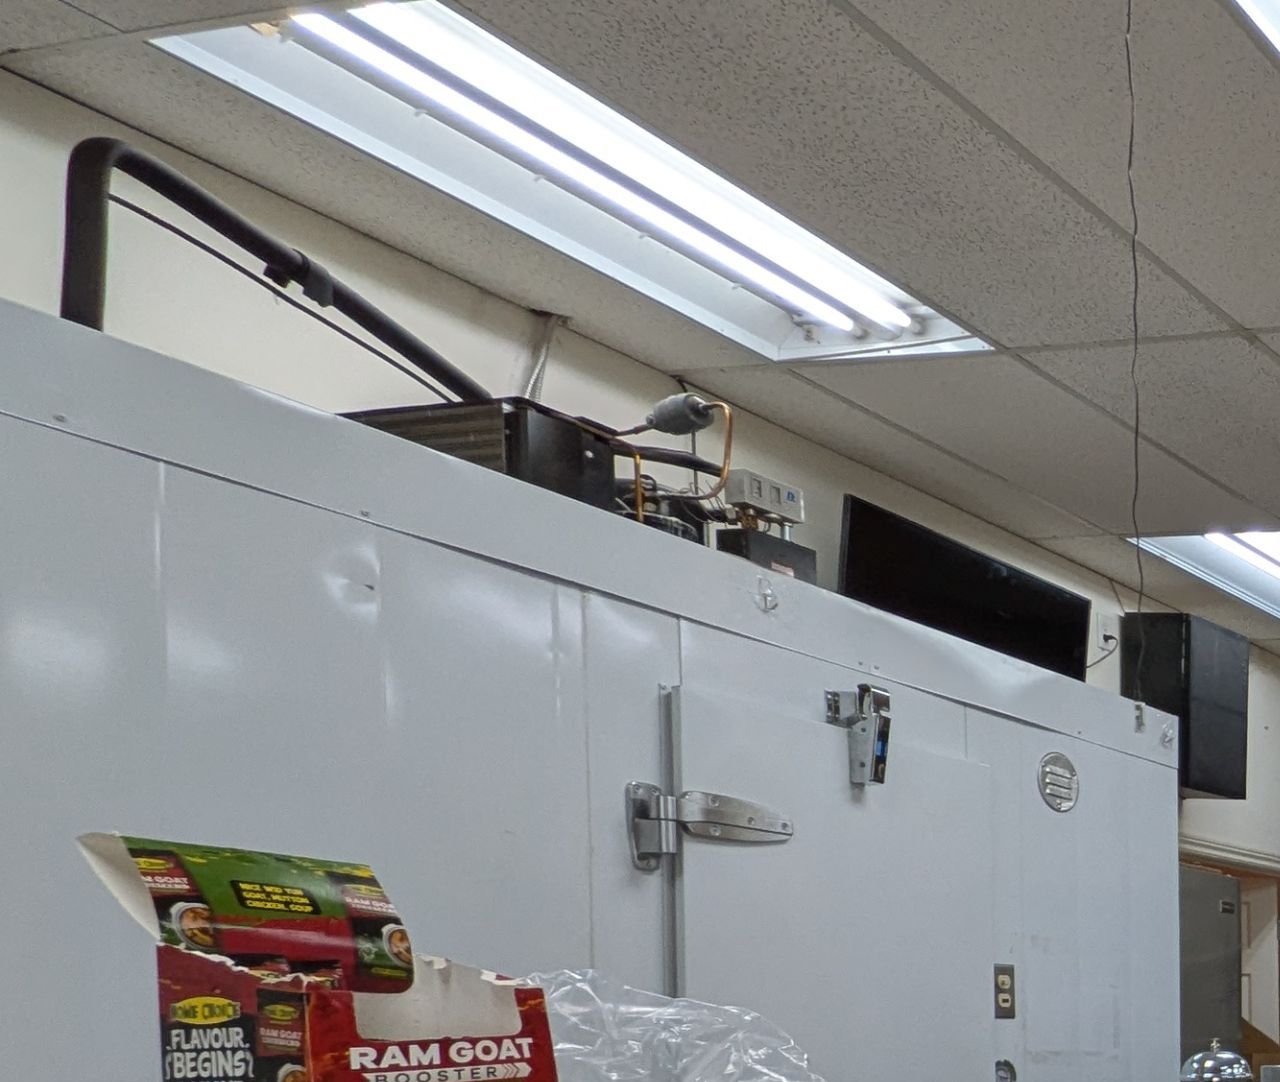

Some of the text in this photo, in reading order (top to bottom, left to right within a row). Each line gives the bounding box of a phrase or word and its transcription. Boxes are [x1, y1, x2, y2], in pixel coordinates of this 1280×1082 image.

[170, 1027, 245, 1050] FLAVOUR
[173, 1050, 247, 1079] BEGINS
[349, 1037, 534, 1070] RAM GOAT
